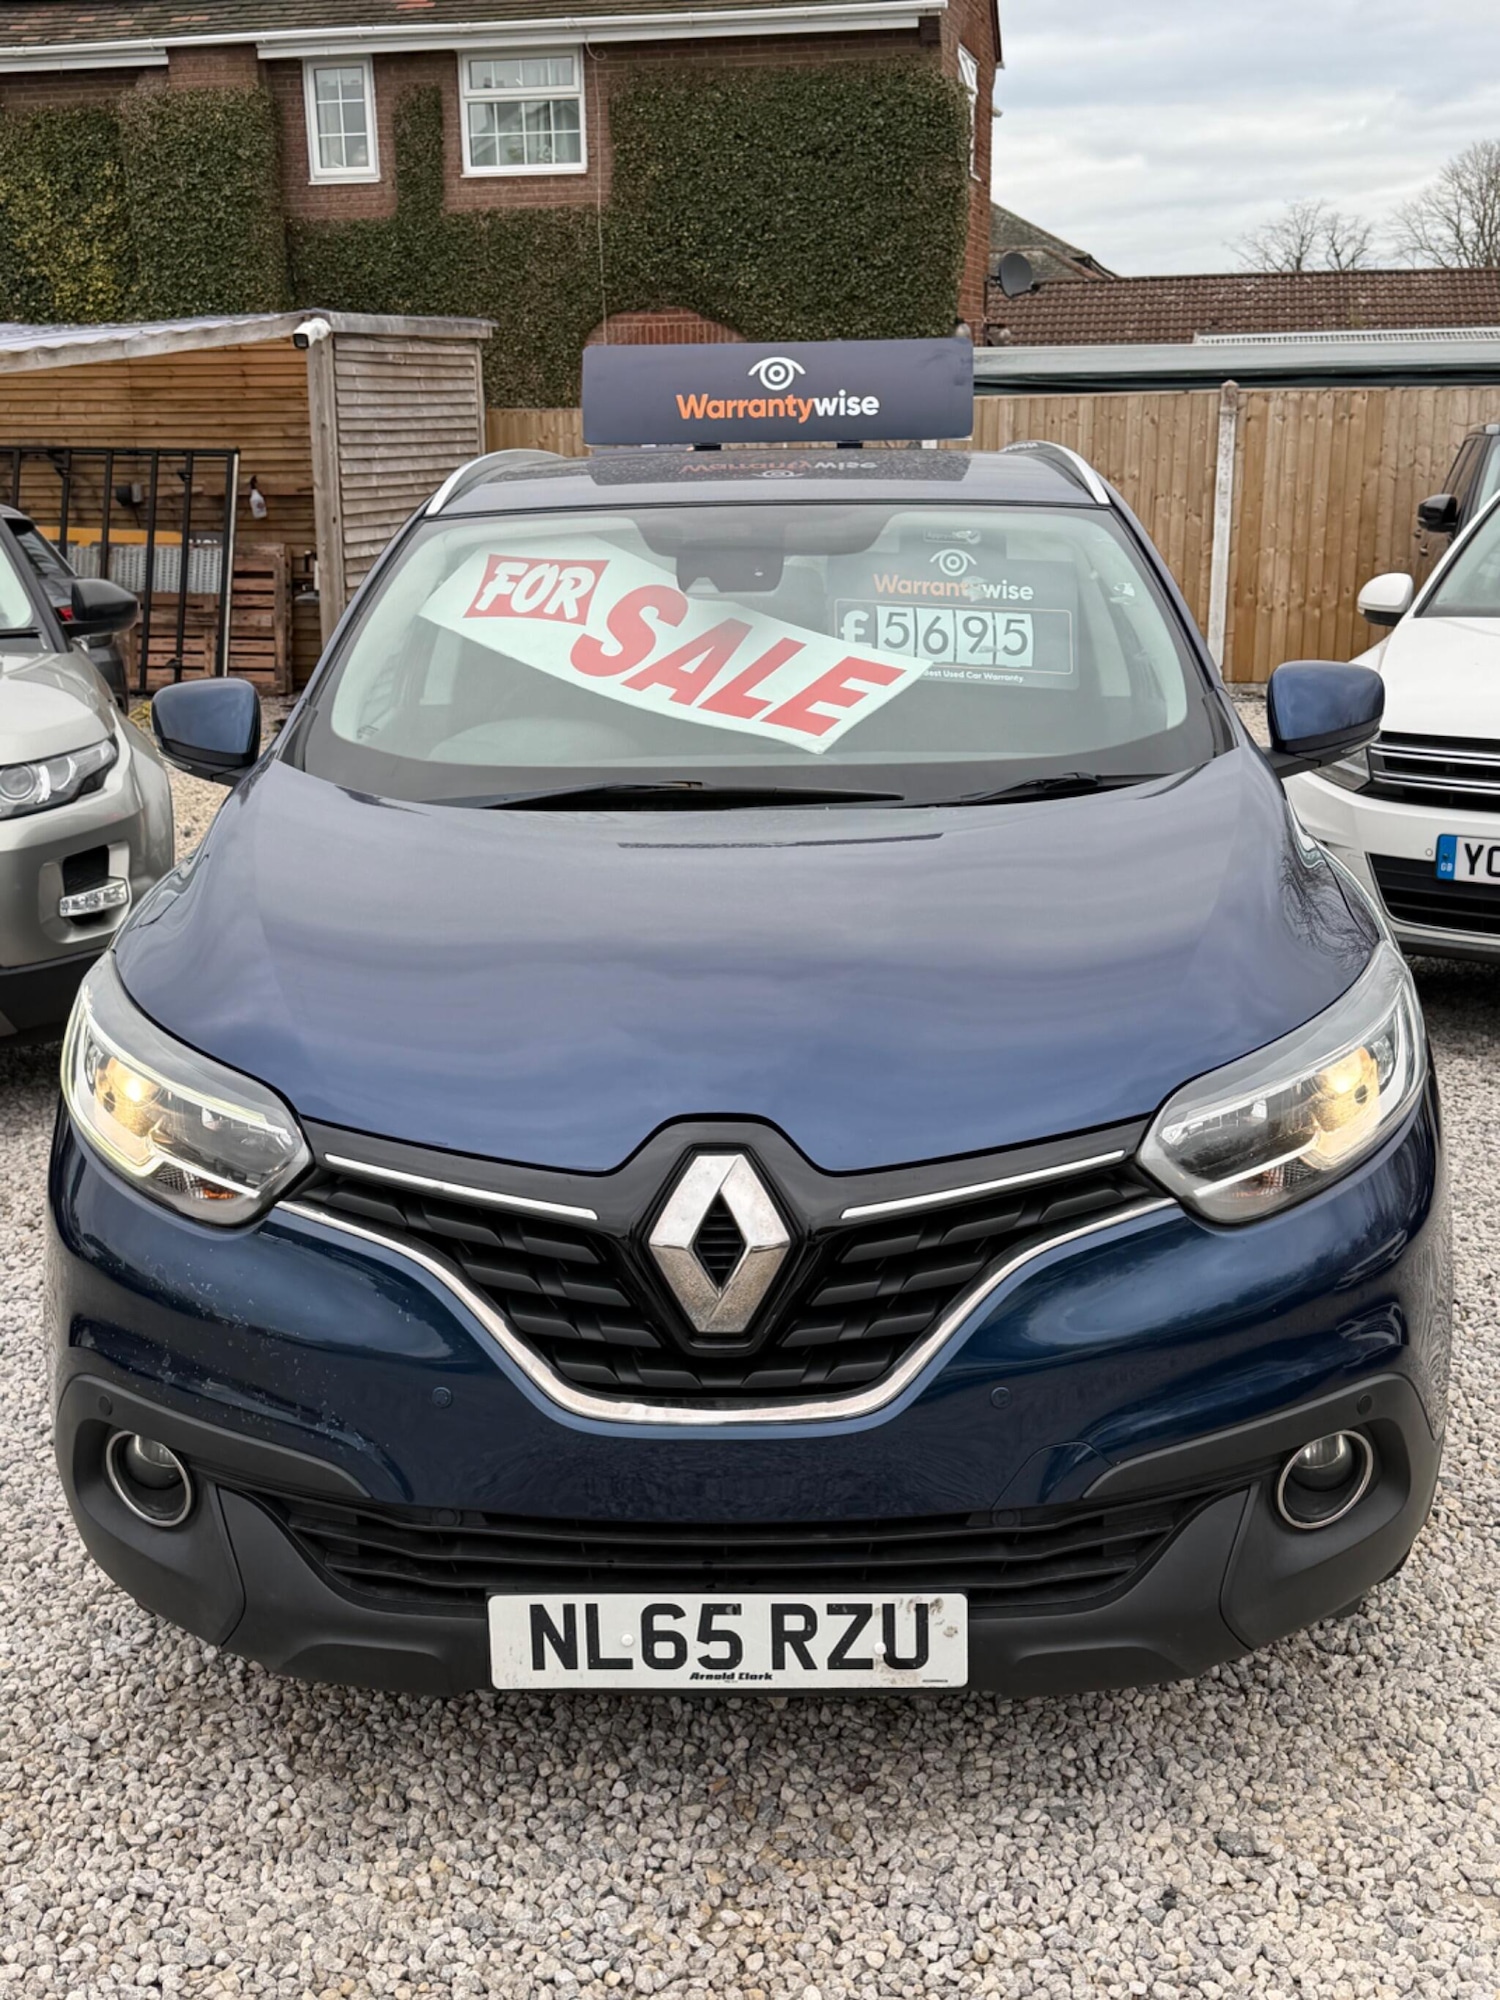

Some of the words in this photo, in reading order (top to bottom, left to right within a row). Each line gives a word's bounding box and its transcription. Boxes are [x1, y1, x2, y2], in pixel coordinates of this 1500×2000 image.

[676, 389, 880, 424] Warrantywise
[475, 560, 596, 621] FOR
[570, 584, 908, 737] SALE
[943, 670, 964, 678] Used
[966, 671, 982, 680] Car
[984, 673, 1024, 683] Warranty
[1440, 862, 1453, 872] GB
[529, 1603, 743, 1671] NL65
[770, 1603, 930, 1671] RZU
[689, 1672, 735, 1681] Arnold
[737, 1672, 773, 1681] Clark
